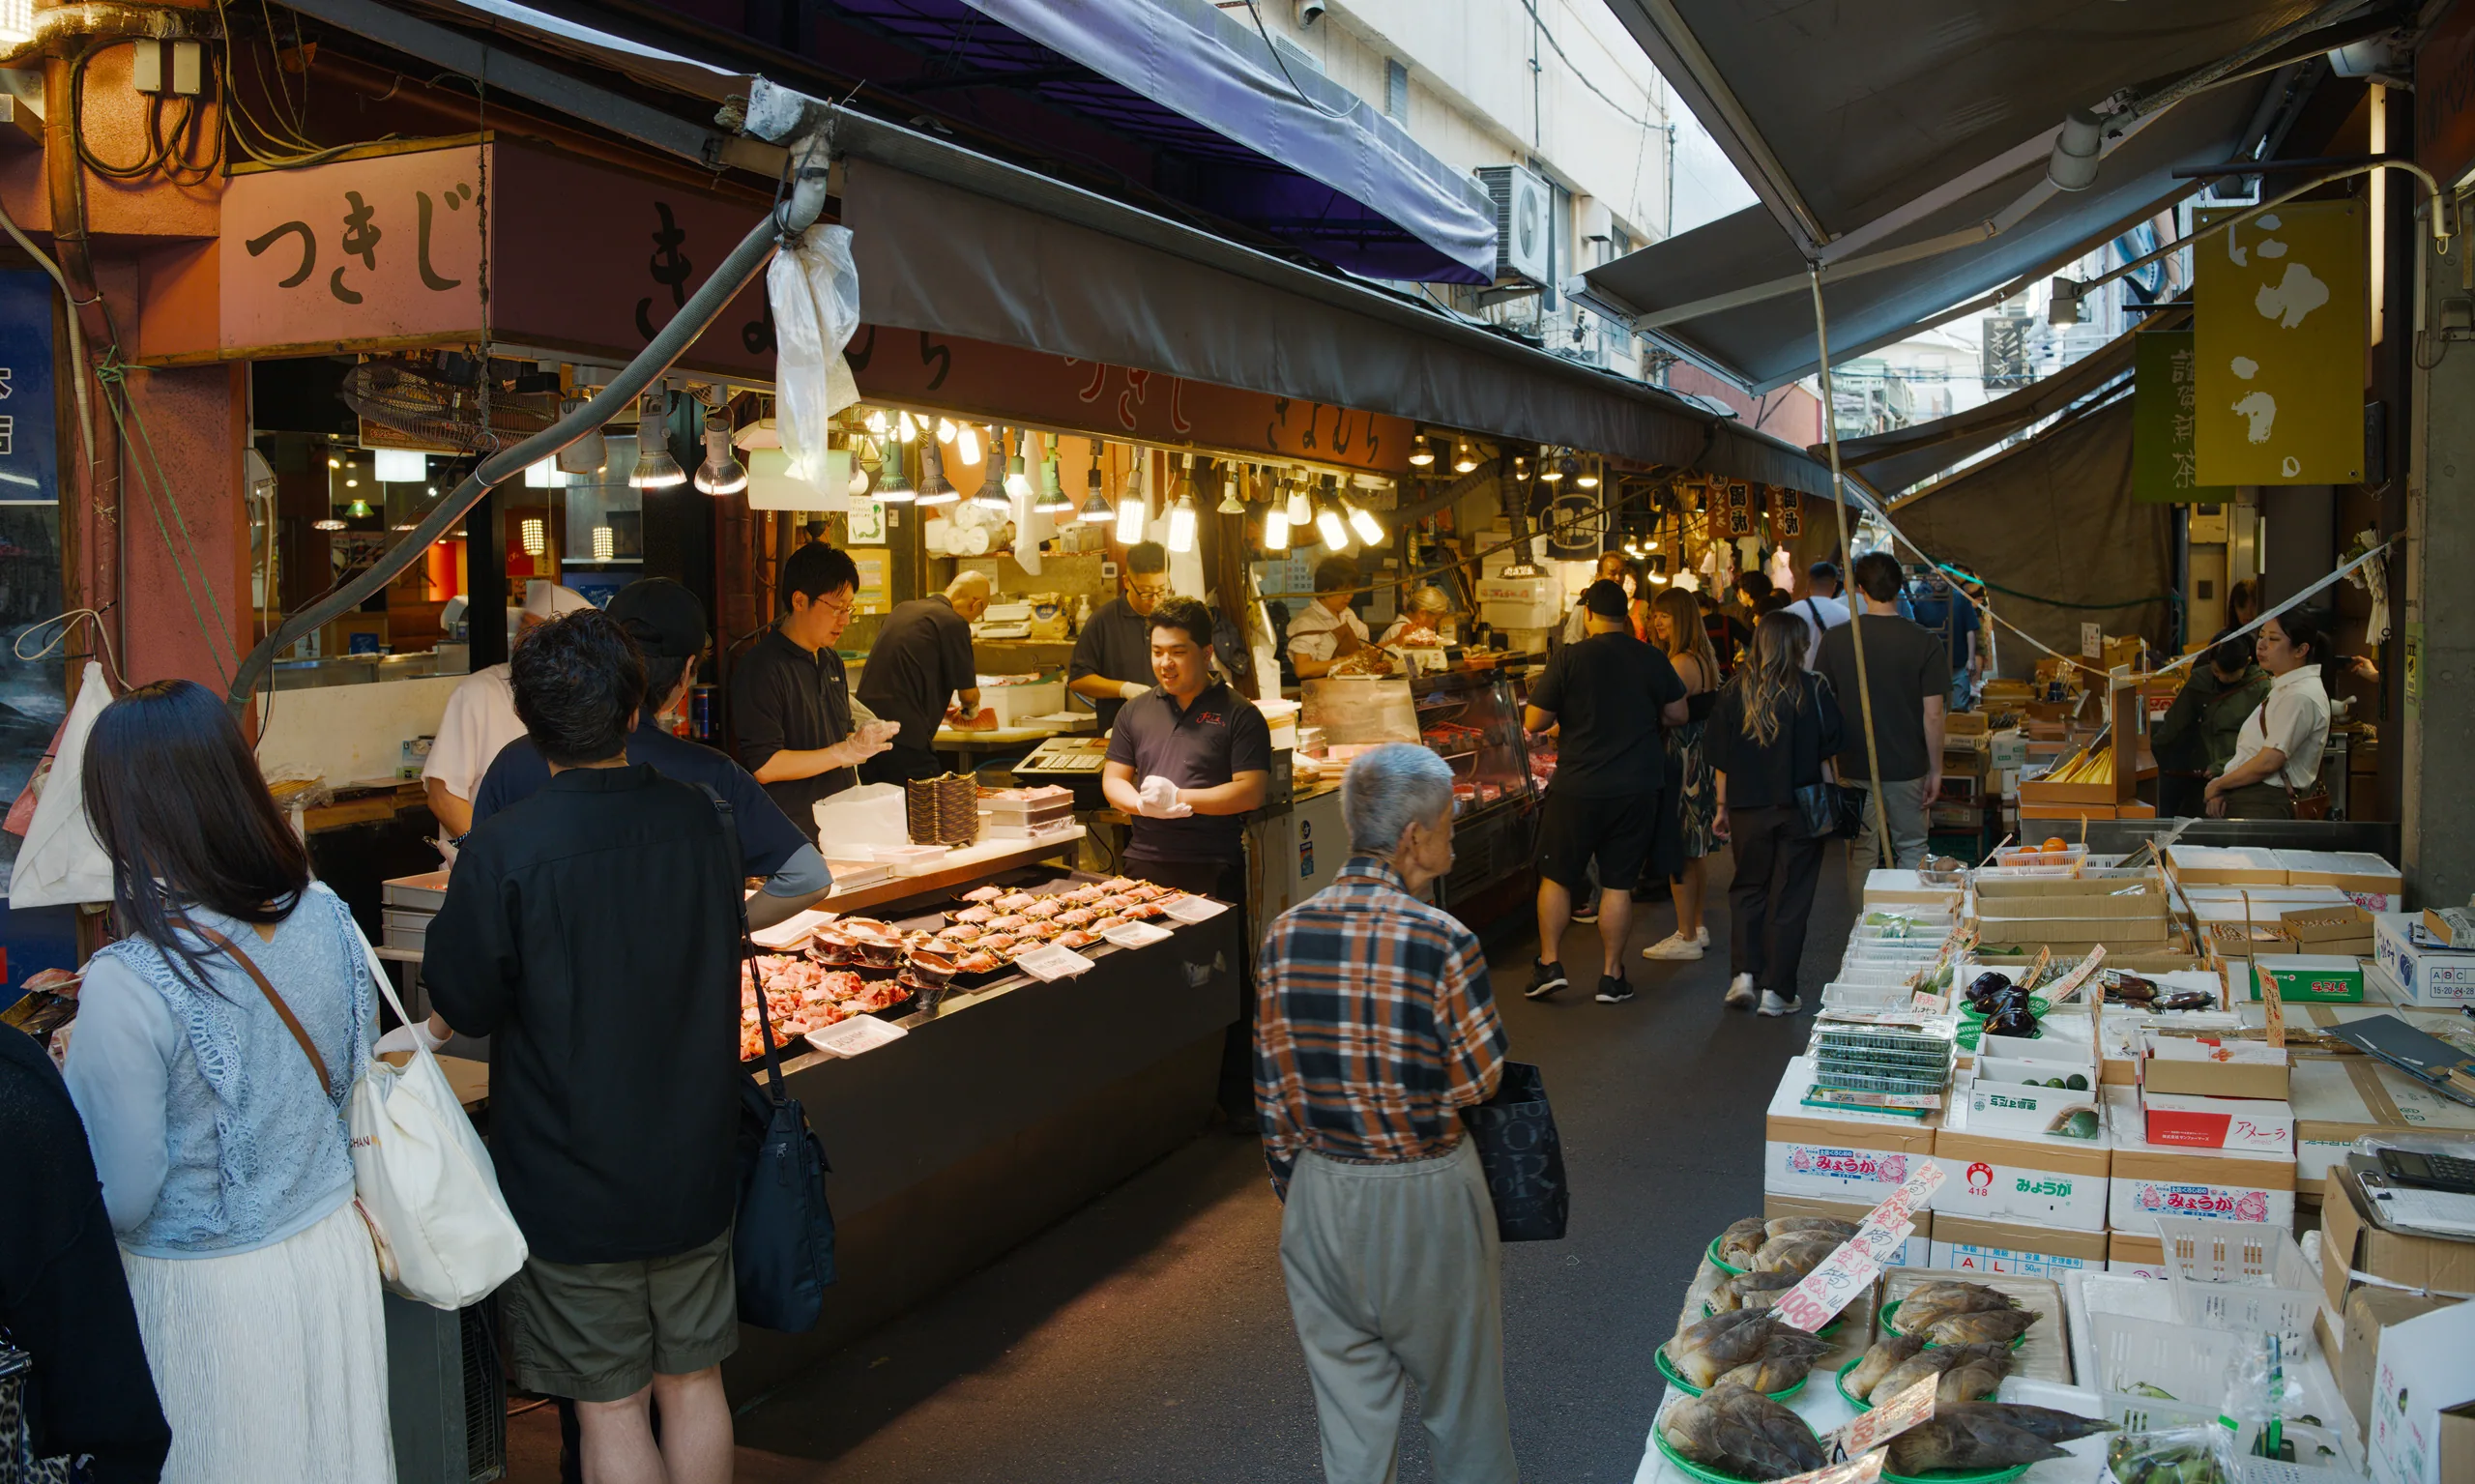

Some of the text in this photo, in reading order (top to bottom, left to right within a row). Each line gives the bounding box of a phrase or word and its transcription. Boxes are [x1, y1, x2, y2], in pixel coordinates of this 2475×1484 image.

[245, 182, 472, 306] つきじ
[2456, 972, 2463, 980] C
[2312, 981, 2349, 993] すだち
[1990, 1097, 2037, 1112] 徳島すだち
[2233, 1120, 2286, 1141] アメーラ
[1816, 1155, 1878, 1175] みょうが
[1968, 1187, 1988, 1197] 418
[2016, 1178, 2073, 1198] みょうが
[2167, 1193, 2234, 1212] みょうが
[1831, 1248, 1872, 1285] 金沢
[1962, 1258, 1974, 1268] A
[1994, 1262, 2005, 1272] L
[1775, 1286, 1830, 1332] 1080
